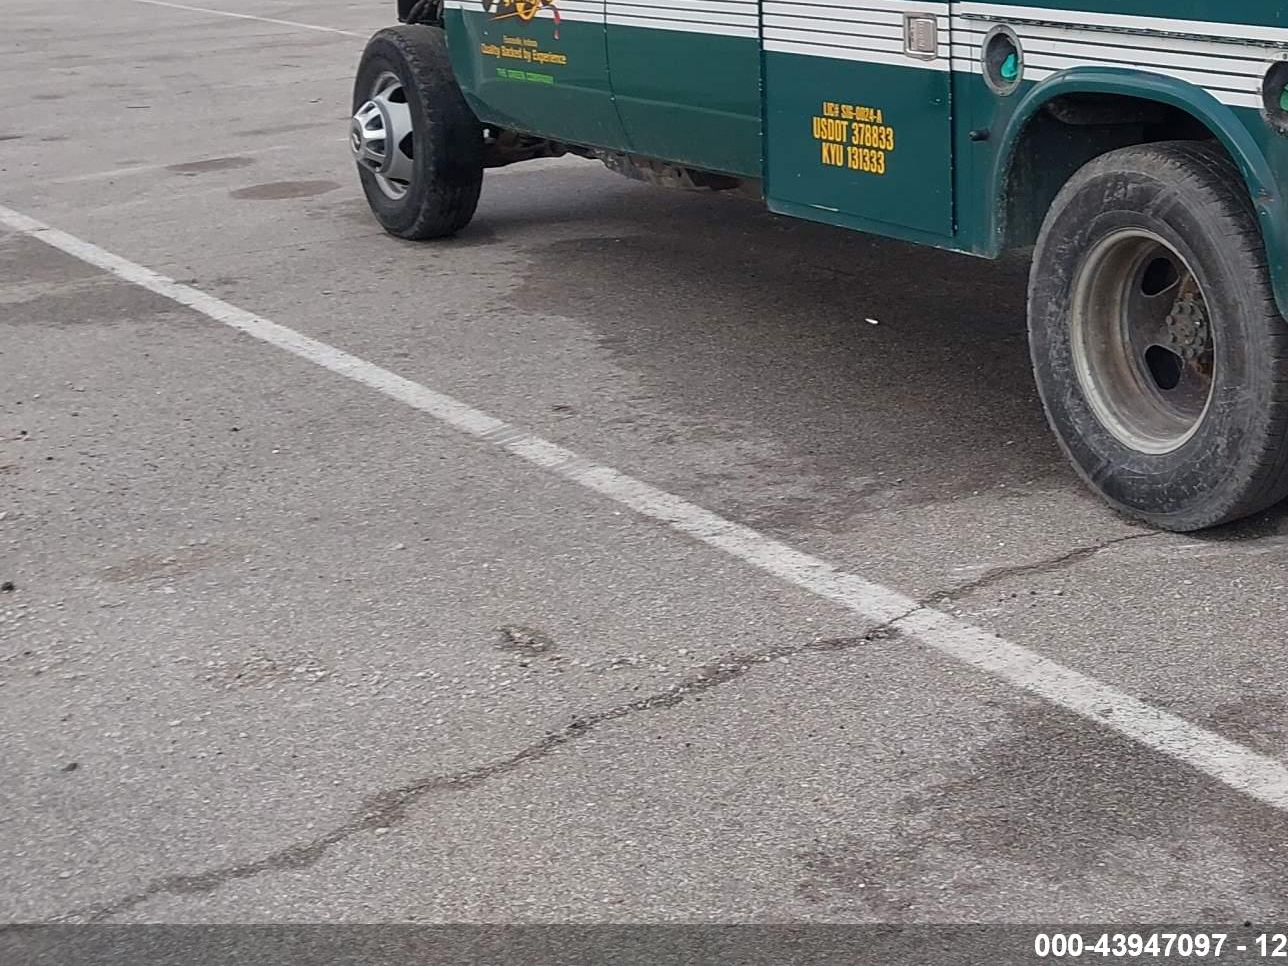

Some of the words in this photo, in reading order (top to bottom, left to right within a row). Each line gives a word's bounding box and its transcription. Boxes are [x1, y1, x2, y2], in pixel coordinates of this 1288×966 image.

[481, 42, 500, 59] Quality
[523, 47, 532, 62] by
[532, 49, 567, 65] Experience
[812, 116, 848, 143] USDOT
[851, 122, 894, 151] 378833
[822, 142, 844, 166] KYU
[847, 146, 885, 174] 131333
